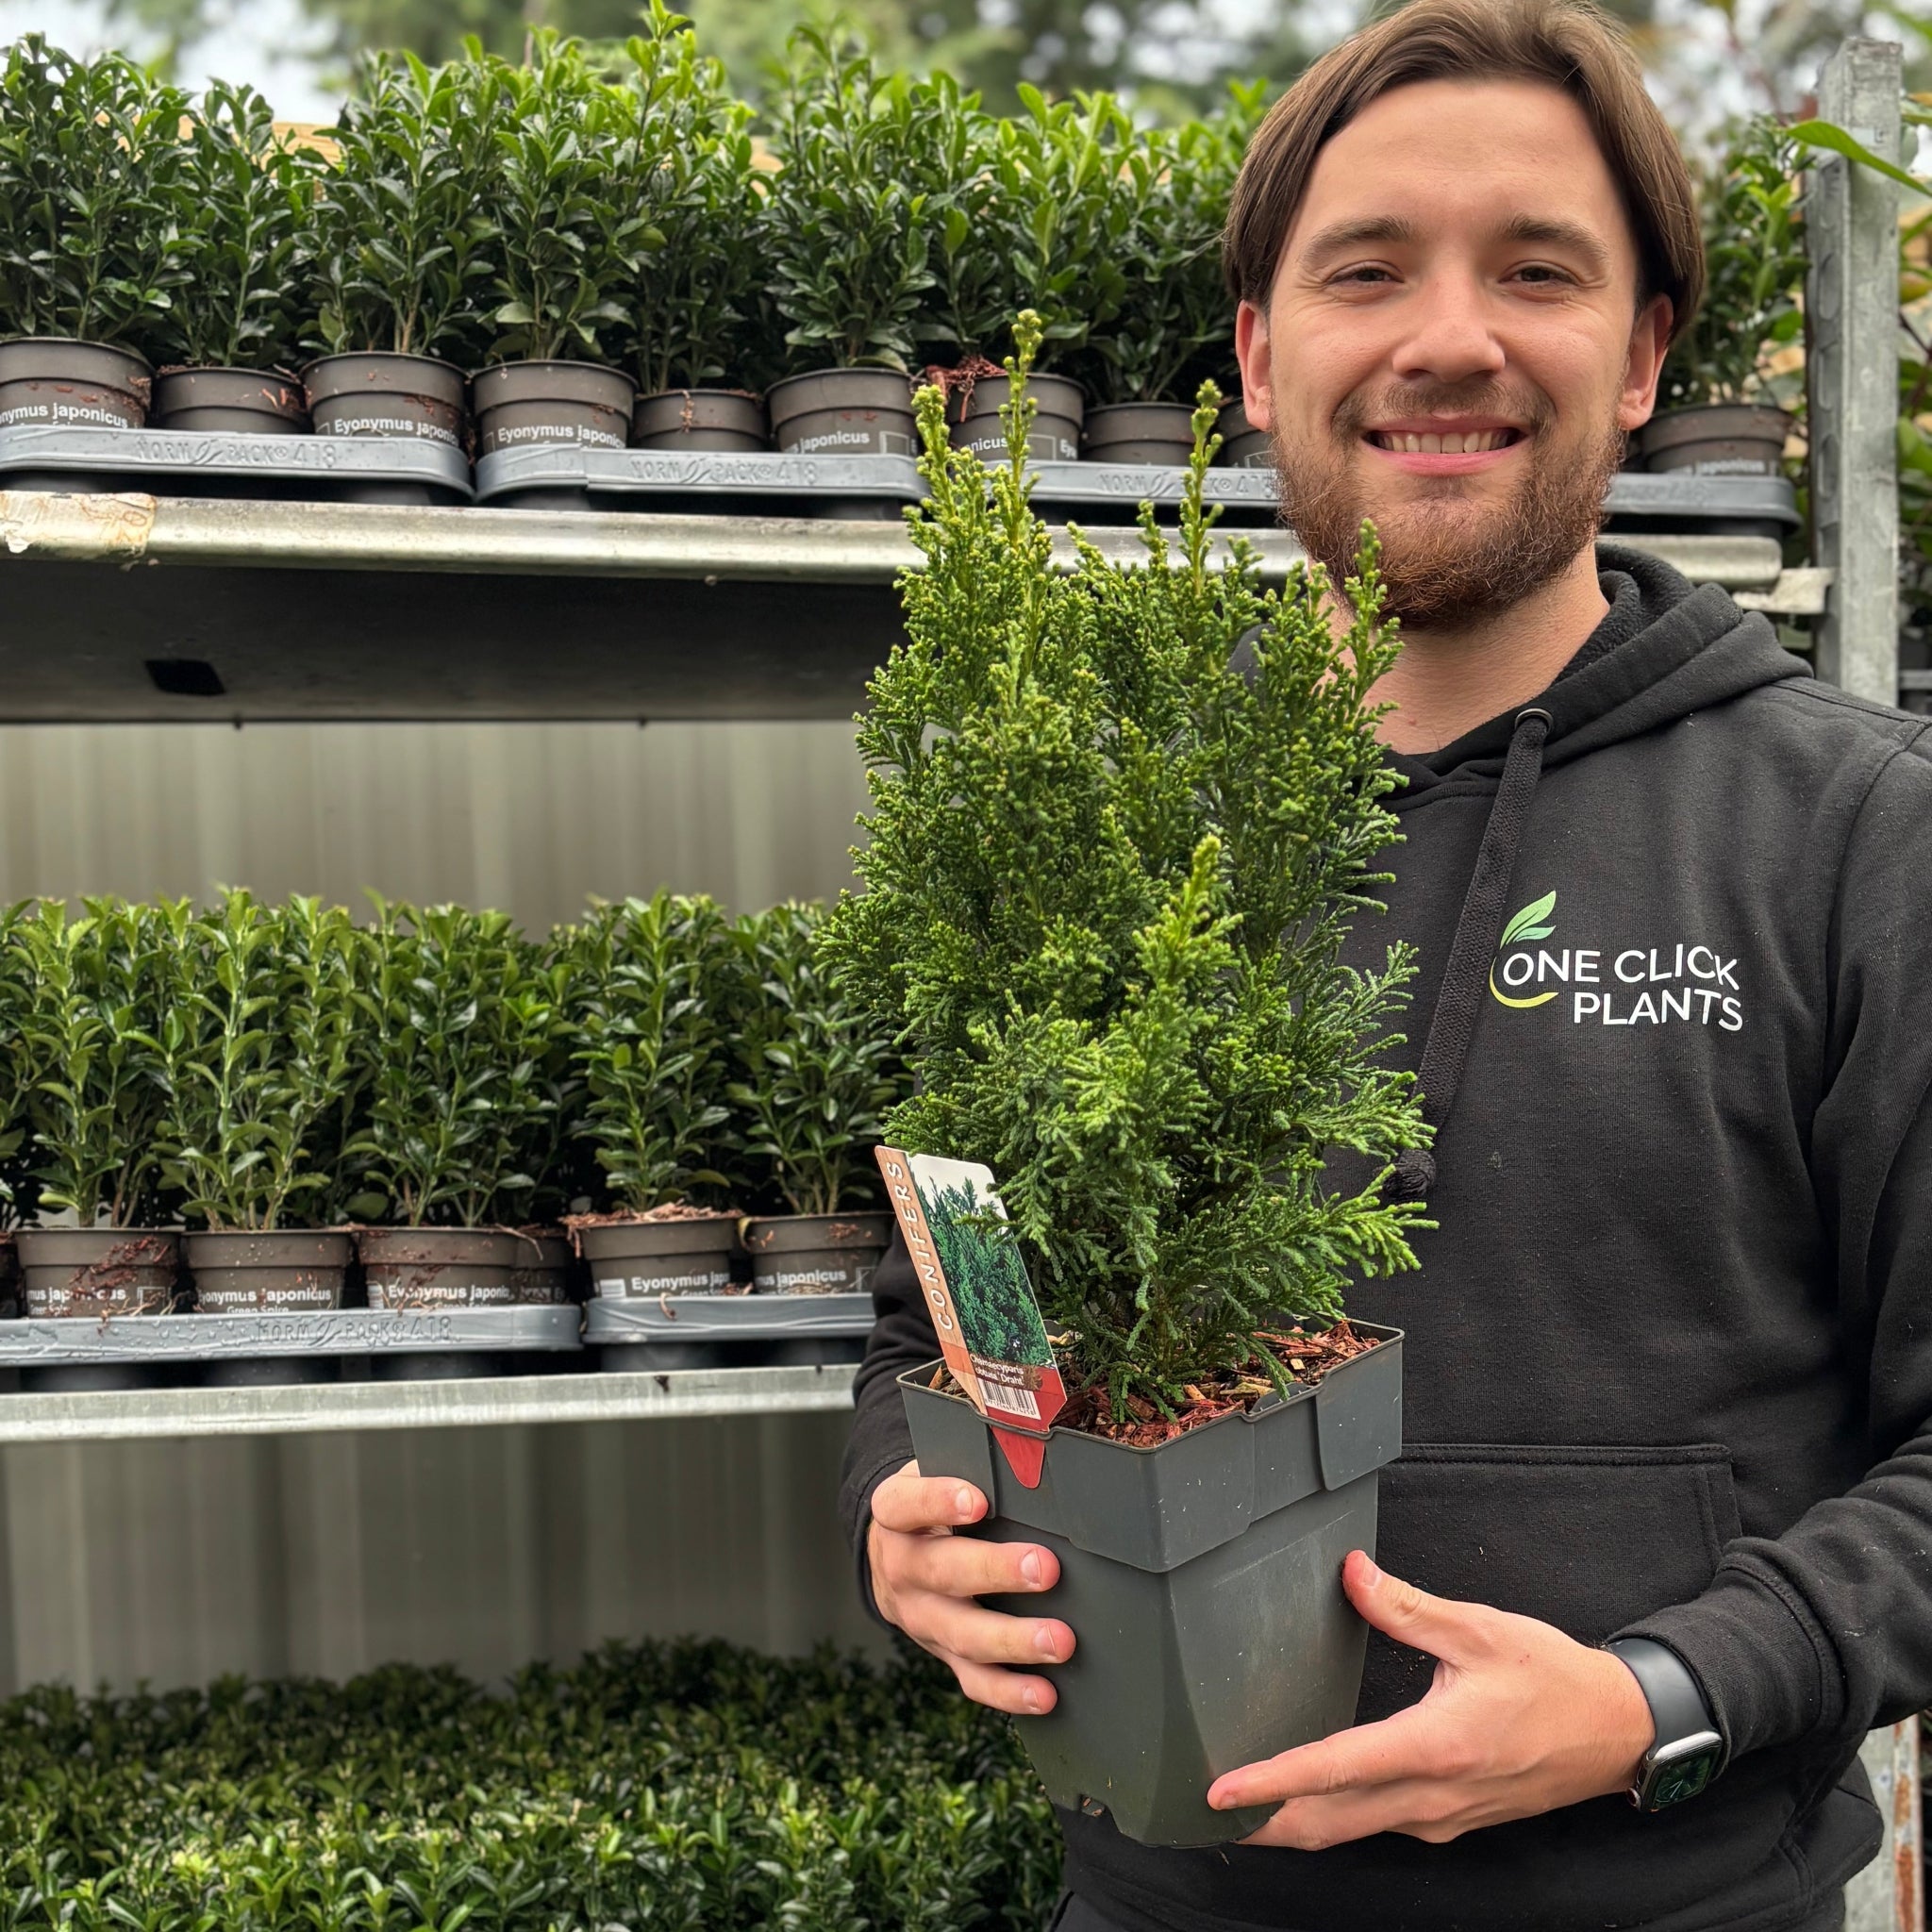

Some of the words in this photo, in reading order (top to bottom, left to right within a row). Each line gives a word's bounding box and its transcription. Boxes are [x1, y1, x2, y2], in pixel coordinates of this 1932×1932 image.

[0, 405, 49, 425] nymus
[52, 402, 128, 429] japonicus
[334, 418, 413, 434] Eyonymus
[498, 425, 574, 443] Eyonymus
[1503, 949, 1601, 986] ONE
[1614, 943, 1740, 991] CLICK
[1574, 988, 1743, 1031] PLANTS
[886, 1161, 954, 1330] CONIFERS
[631, 1274, 708, 1293] Eyonymus
[777, 1270, 847, 1288] japonicus
